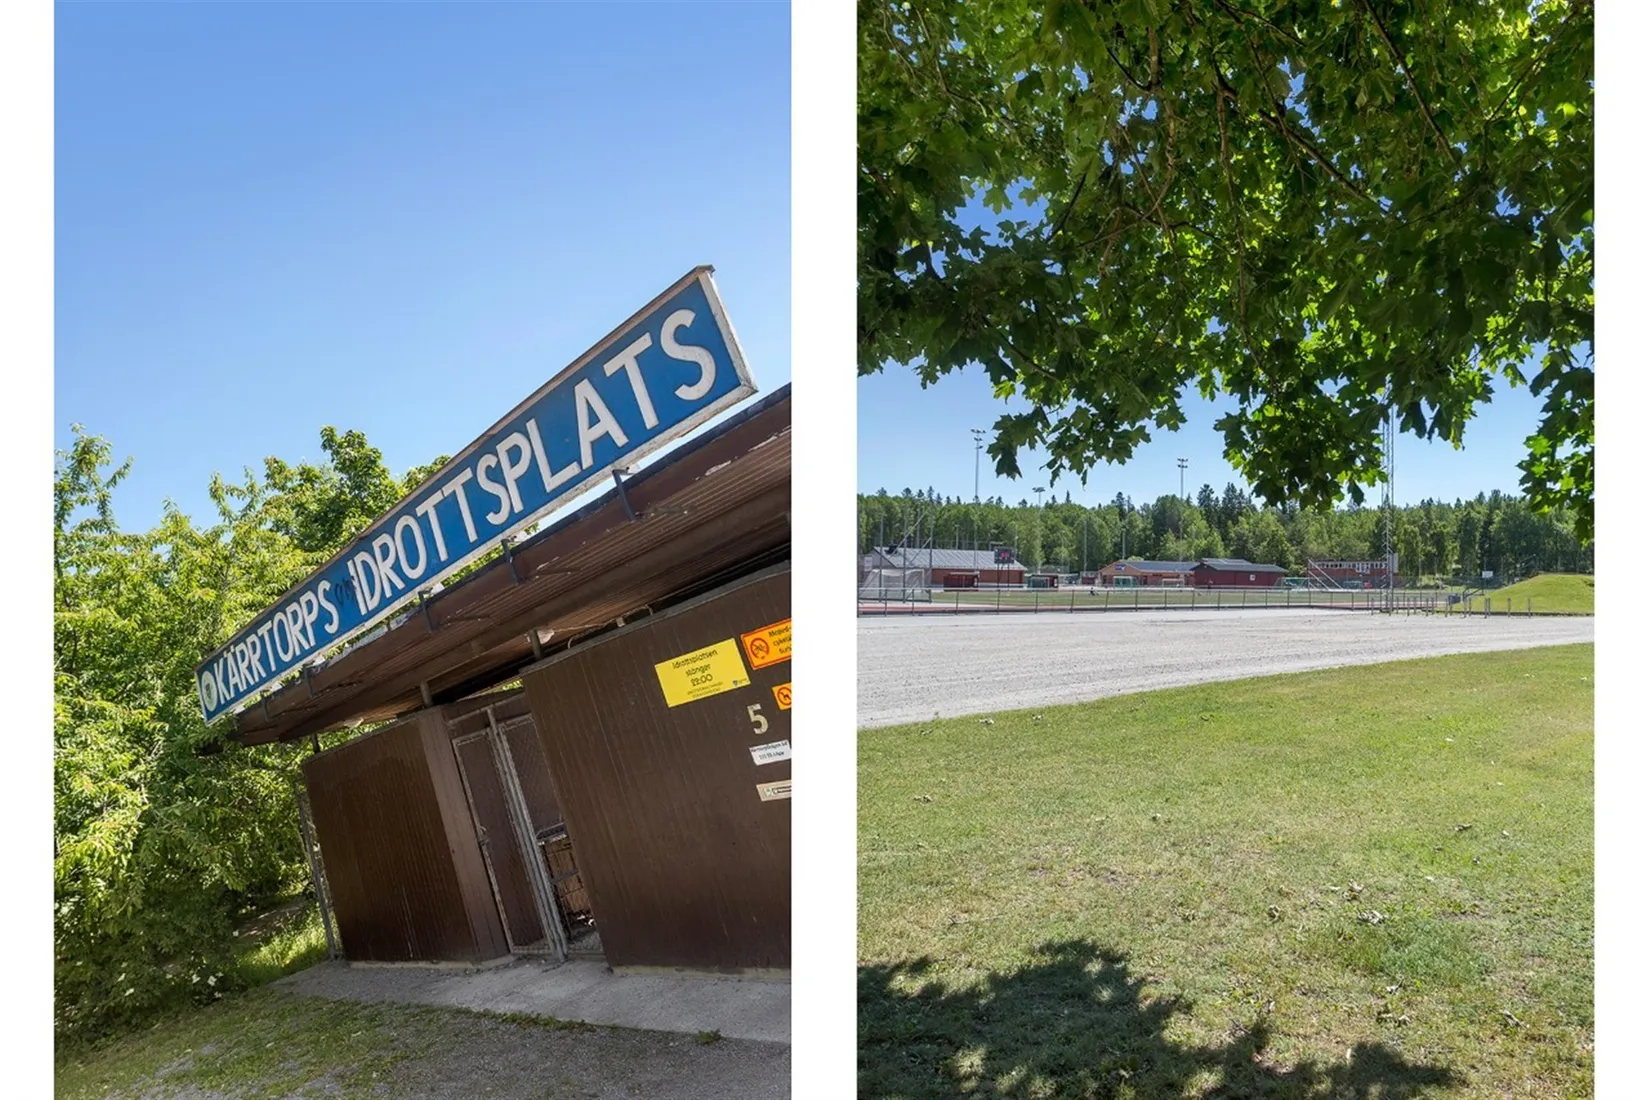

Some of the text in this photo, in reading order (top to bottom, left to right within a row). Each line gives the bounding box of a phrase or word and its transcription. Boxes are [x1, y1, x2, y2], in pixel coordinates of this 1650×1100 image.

[213, 309, 716, 704] KÄRRTORPS IDROTTSPLATS
[691, 673, 713, 687] 22:00
[747, 703, 769, 734] 5
